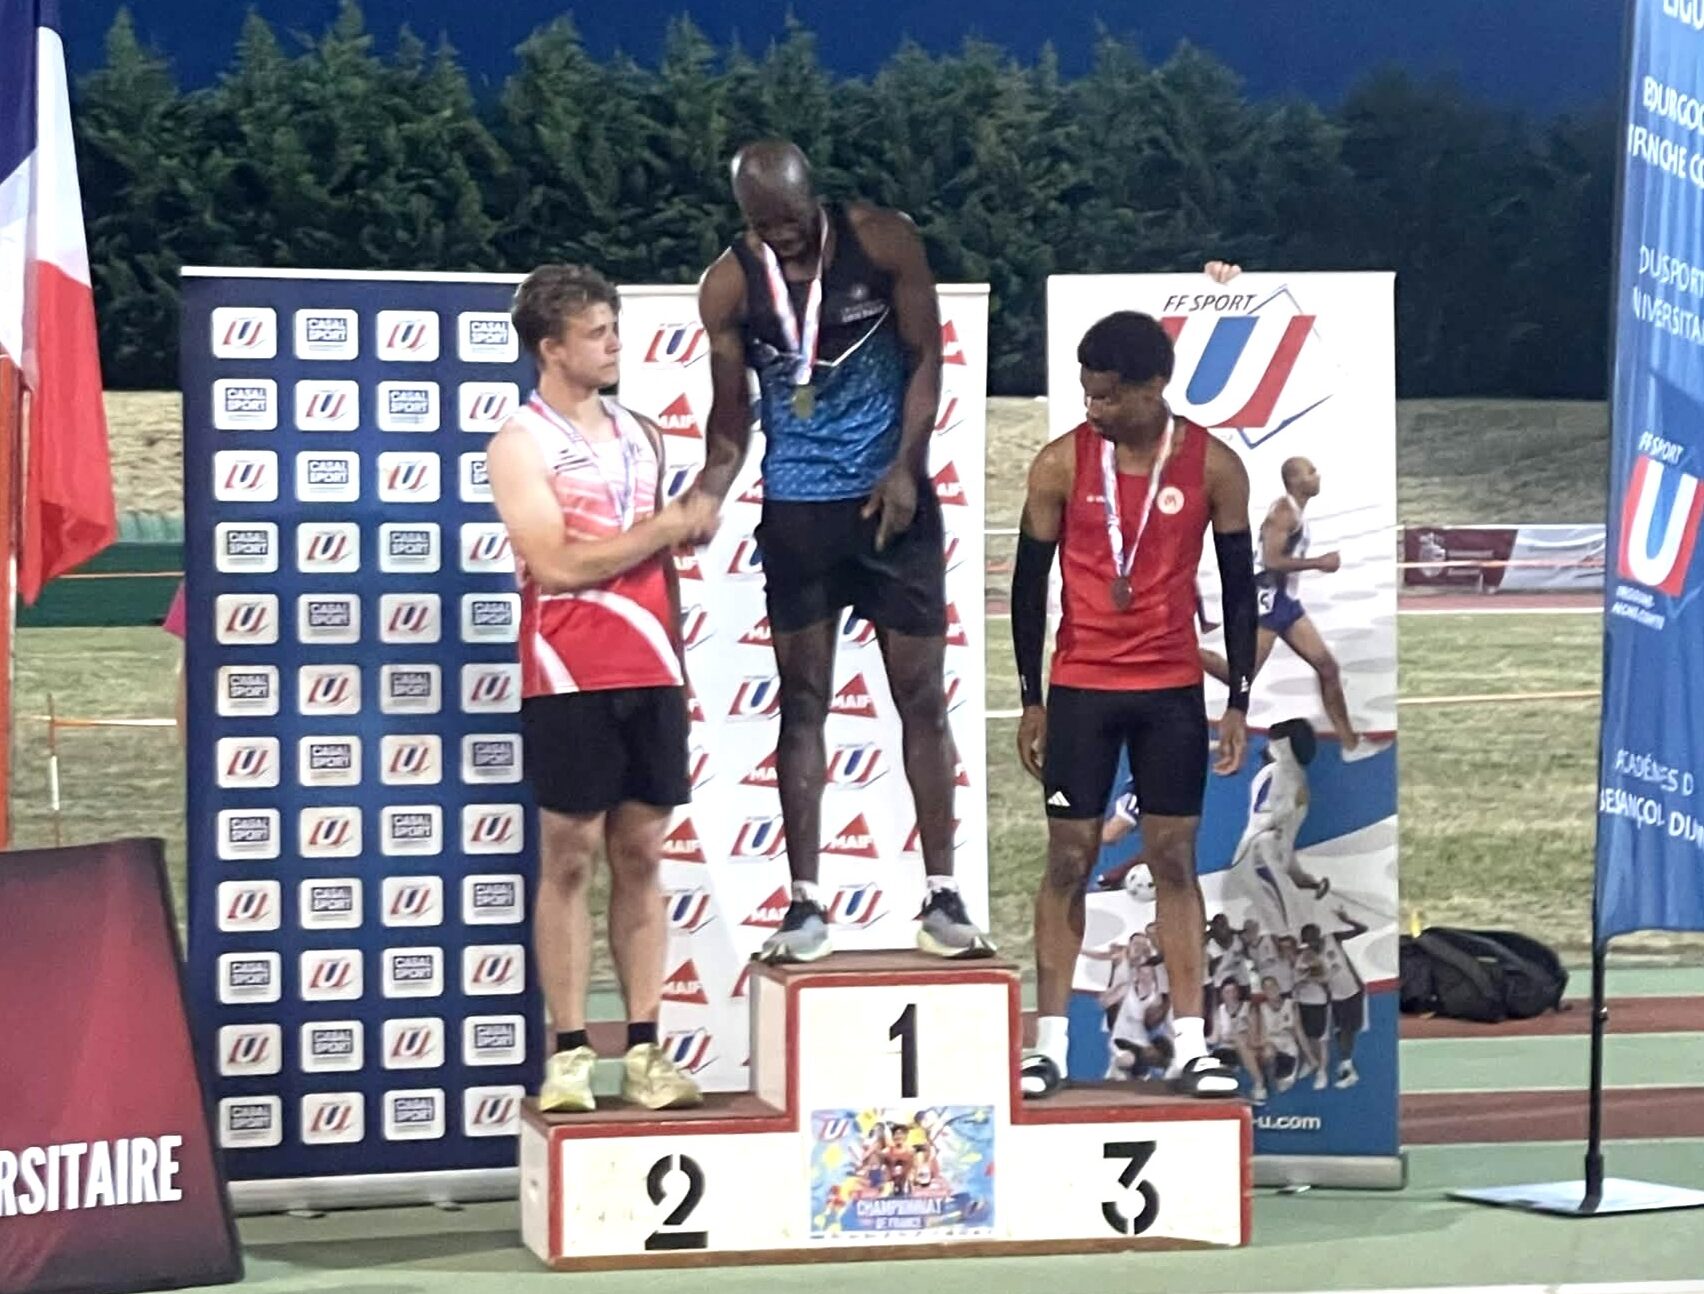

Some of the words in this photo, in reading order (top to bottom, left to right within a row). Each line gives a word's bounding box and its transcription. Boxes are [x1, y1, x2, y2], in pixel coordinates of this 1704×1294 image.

[1163, 295, 1190, 312] FF
[1188, 294, 1257, 312] SPORT
[1628, 459, 1698, 586] U
[834, 693, 871, 709] MAIF
[751, 767, 777, 781] MA
[661, 839, 700, 853] MAIF
[832, 834, 873, 850] MAIF
[661, 980, 703, 994] MAIF
[889, 1003, 919, 1098] 1
[0, 1135, 182, 1217] RSITAIRE
[1102, 1140, 1160, 1237] 3
[645, 1153, 708, 1250] 2
